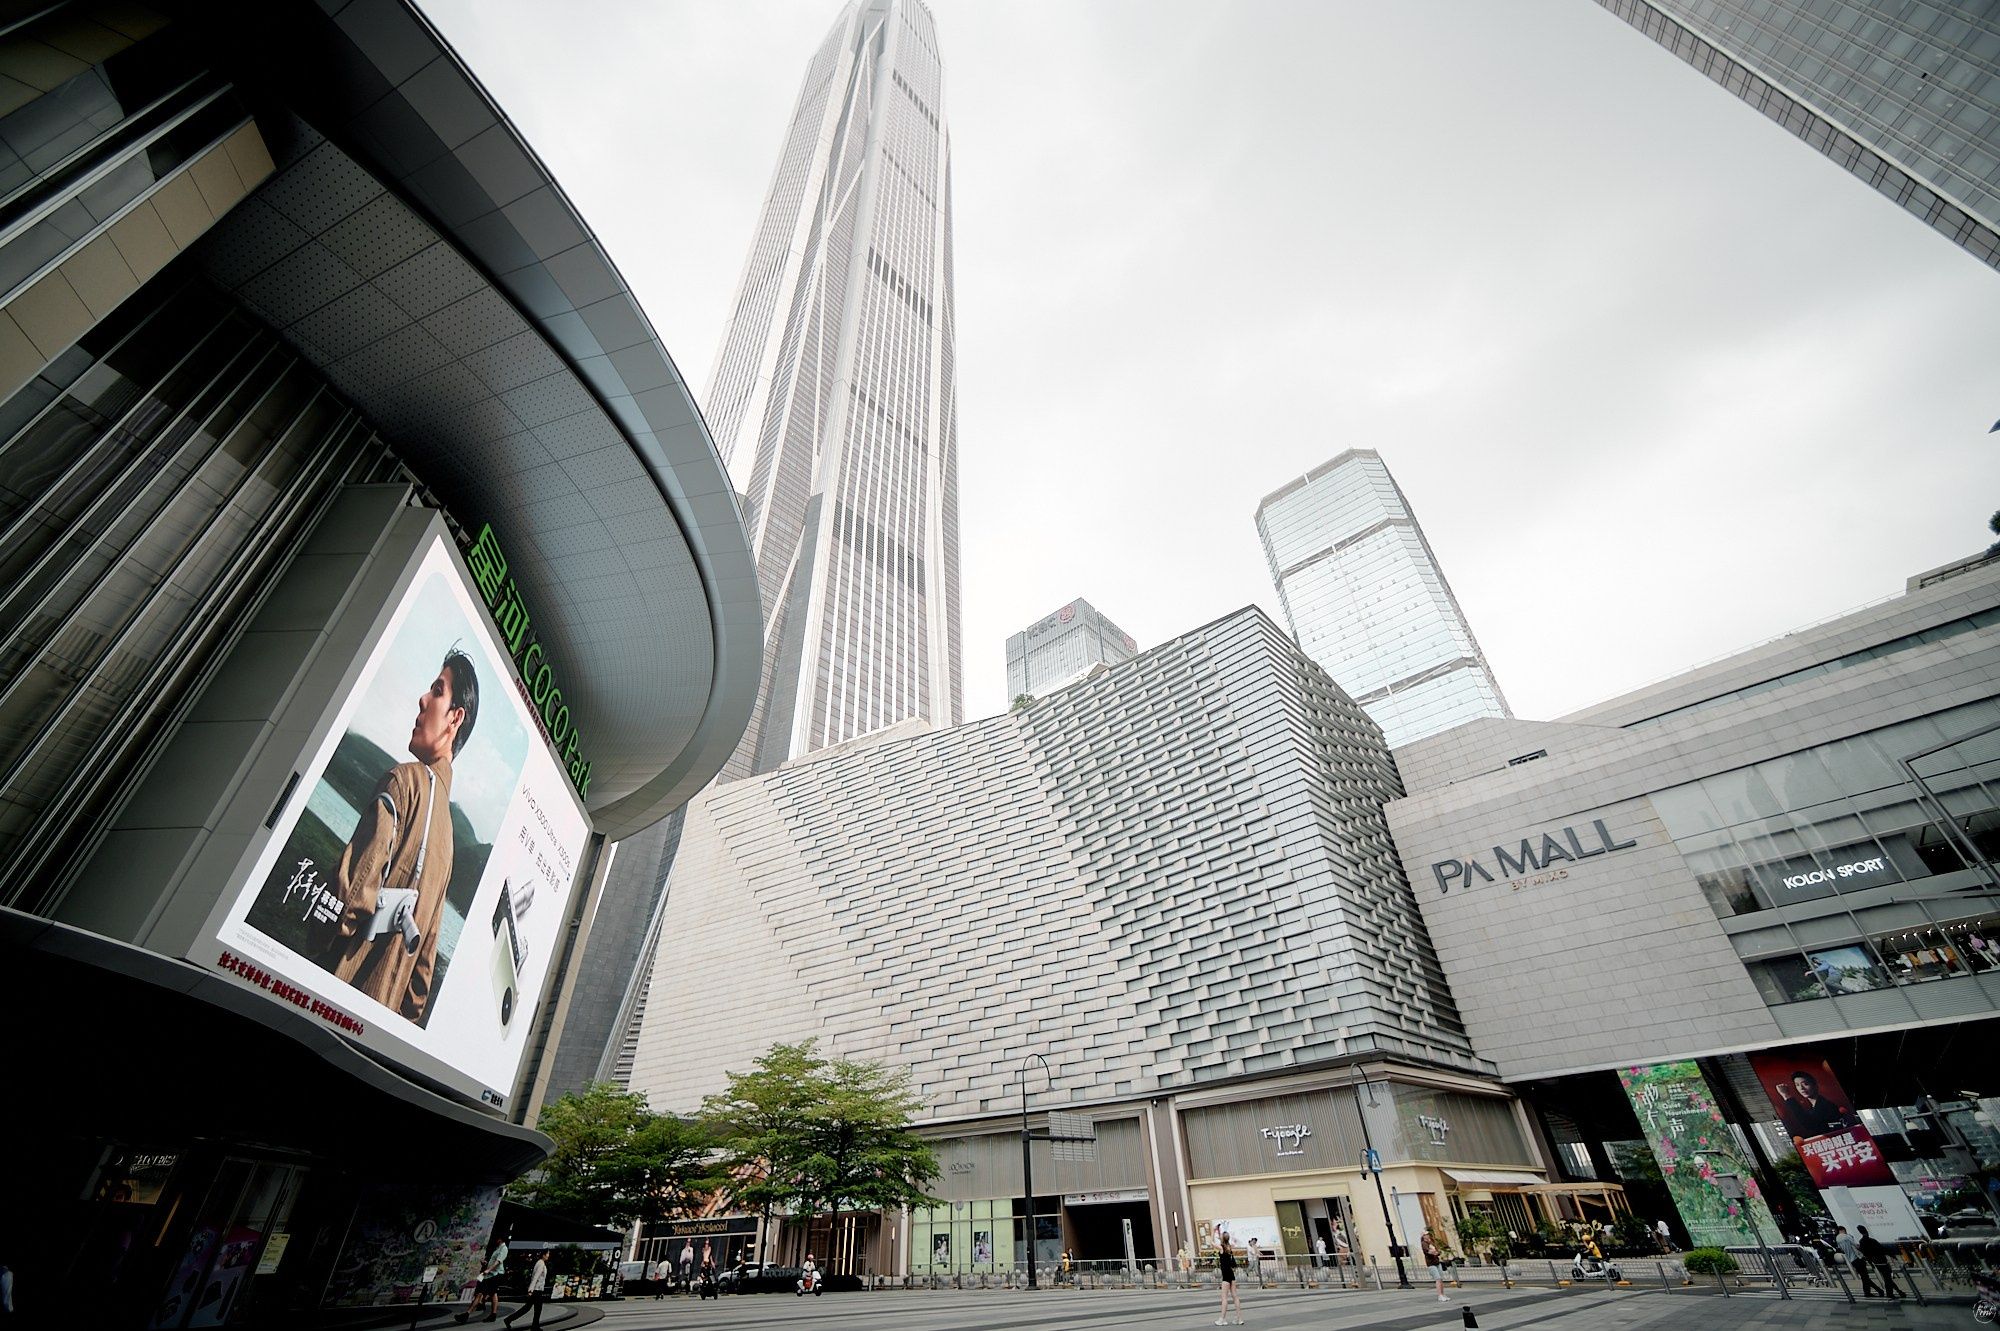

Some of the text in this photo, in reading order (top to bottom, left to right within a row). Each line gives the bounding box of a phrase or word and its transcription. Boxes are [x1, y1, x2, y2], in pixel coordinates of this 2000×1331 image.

[467, 522, 530, 655] 星河
[523, 643, 569, 743] COCO
[564, 727, 592, 801] Park
[522, 783, 536, 810] vivo
[535, 804, 548, 830] X300
[1493, 819, 1637, 878] MALL
[1510, 869, 1569, 891] BY MIXC
[1783, 857, 1885, 890] KOLON SPORT
[1801, 1132, 1856, 1157] 买保险就是
[1818, 1141, 1878, 1173] 买平安
